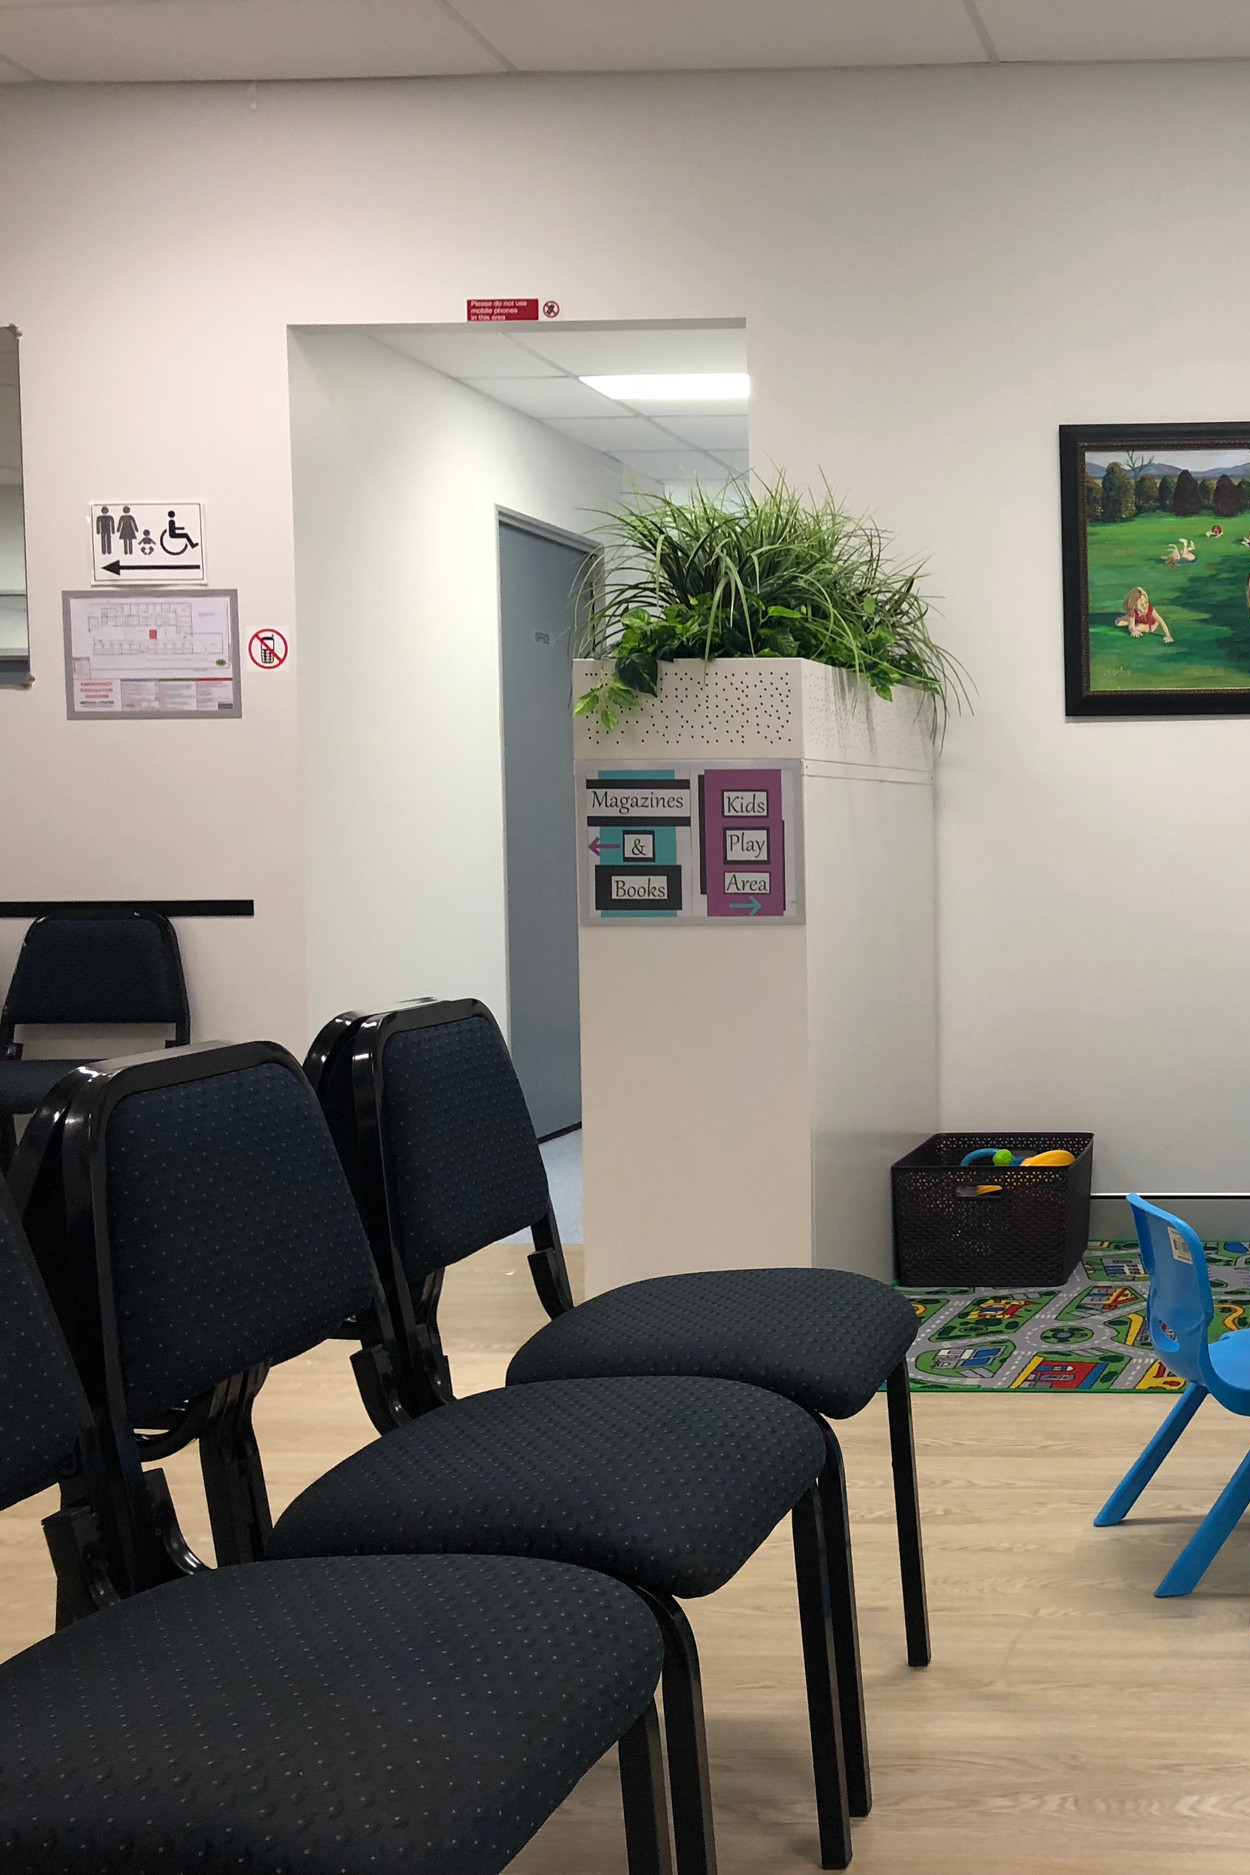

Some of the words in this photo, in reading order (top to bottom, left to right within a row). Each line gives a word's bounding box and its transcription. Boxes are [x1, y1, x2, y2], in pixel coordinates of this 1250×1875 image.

[591, 790, 684, 814] Magazines
[726, 793, 766, 814] Kids
[631, 838, 648, 856] &
[728, 832, 766, 858] Play
[615, 878, 666, 898] Books
[726, 873, 768, 892] Area
